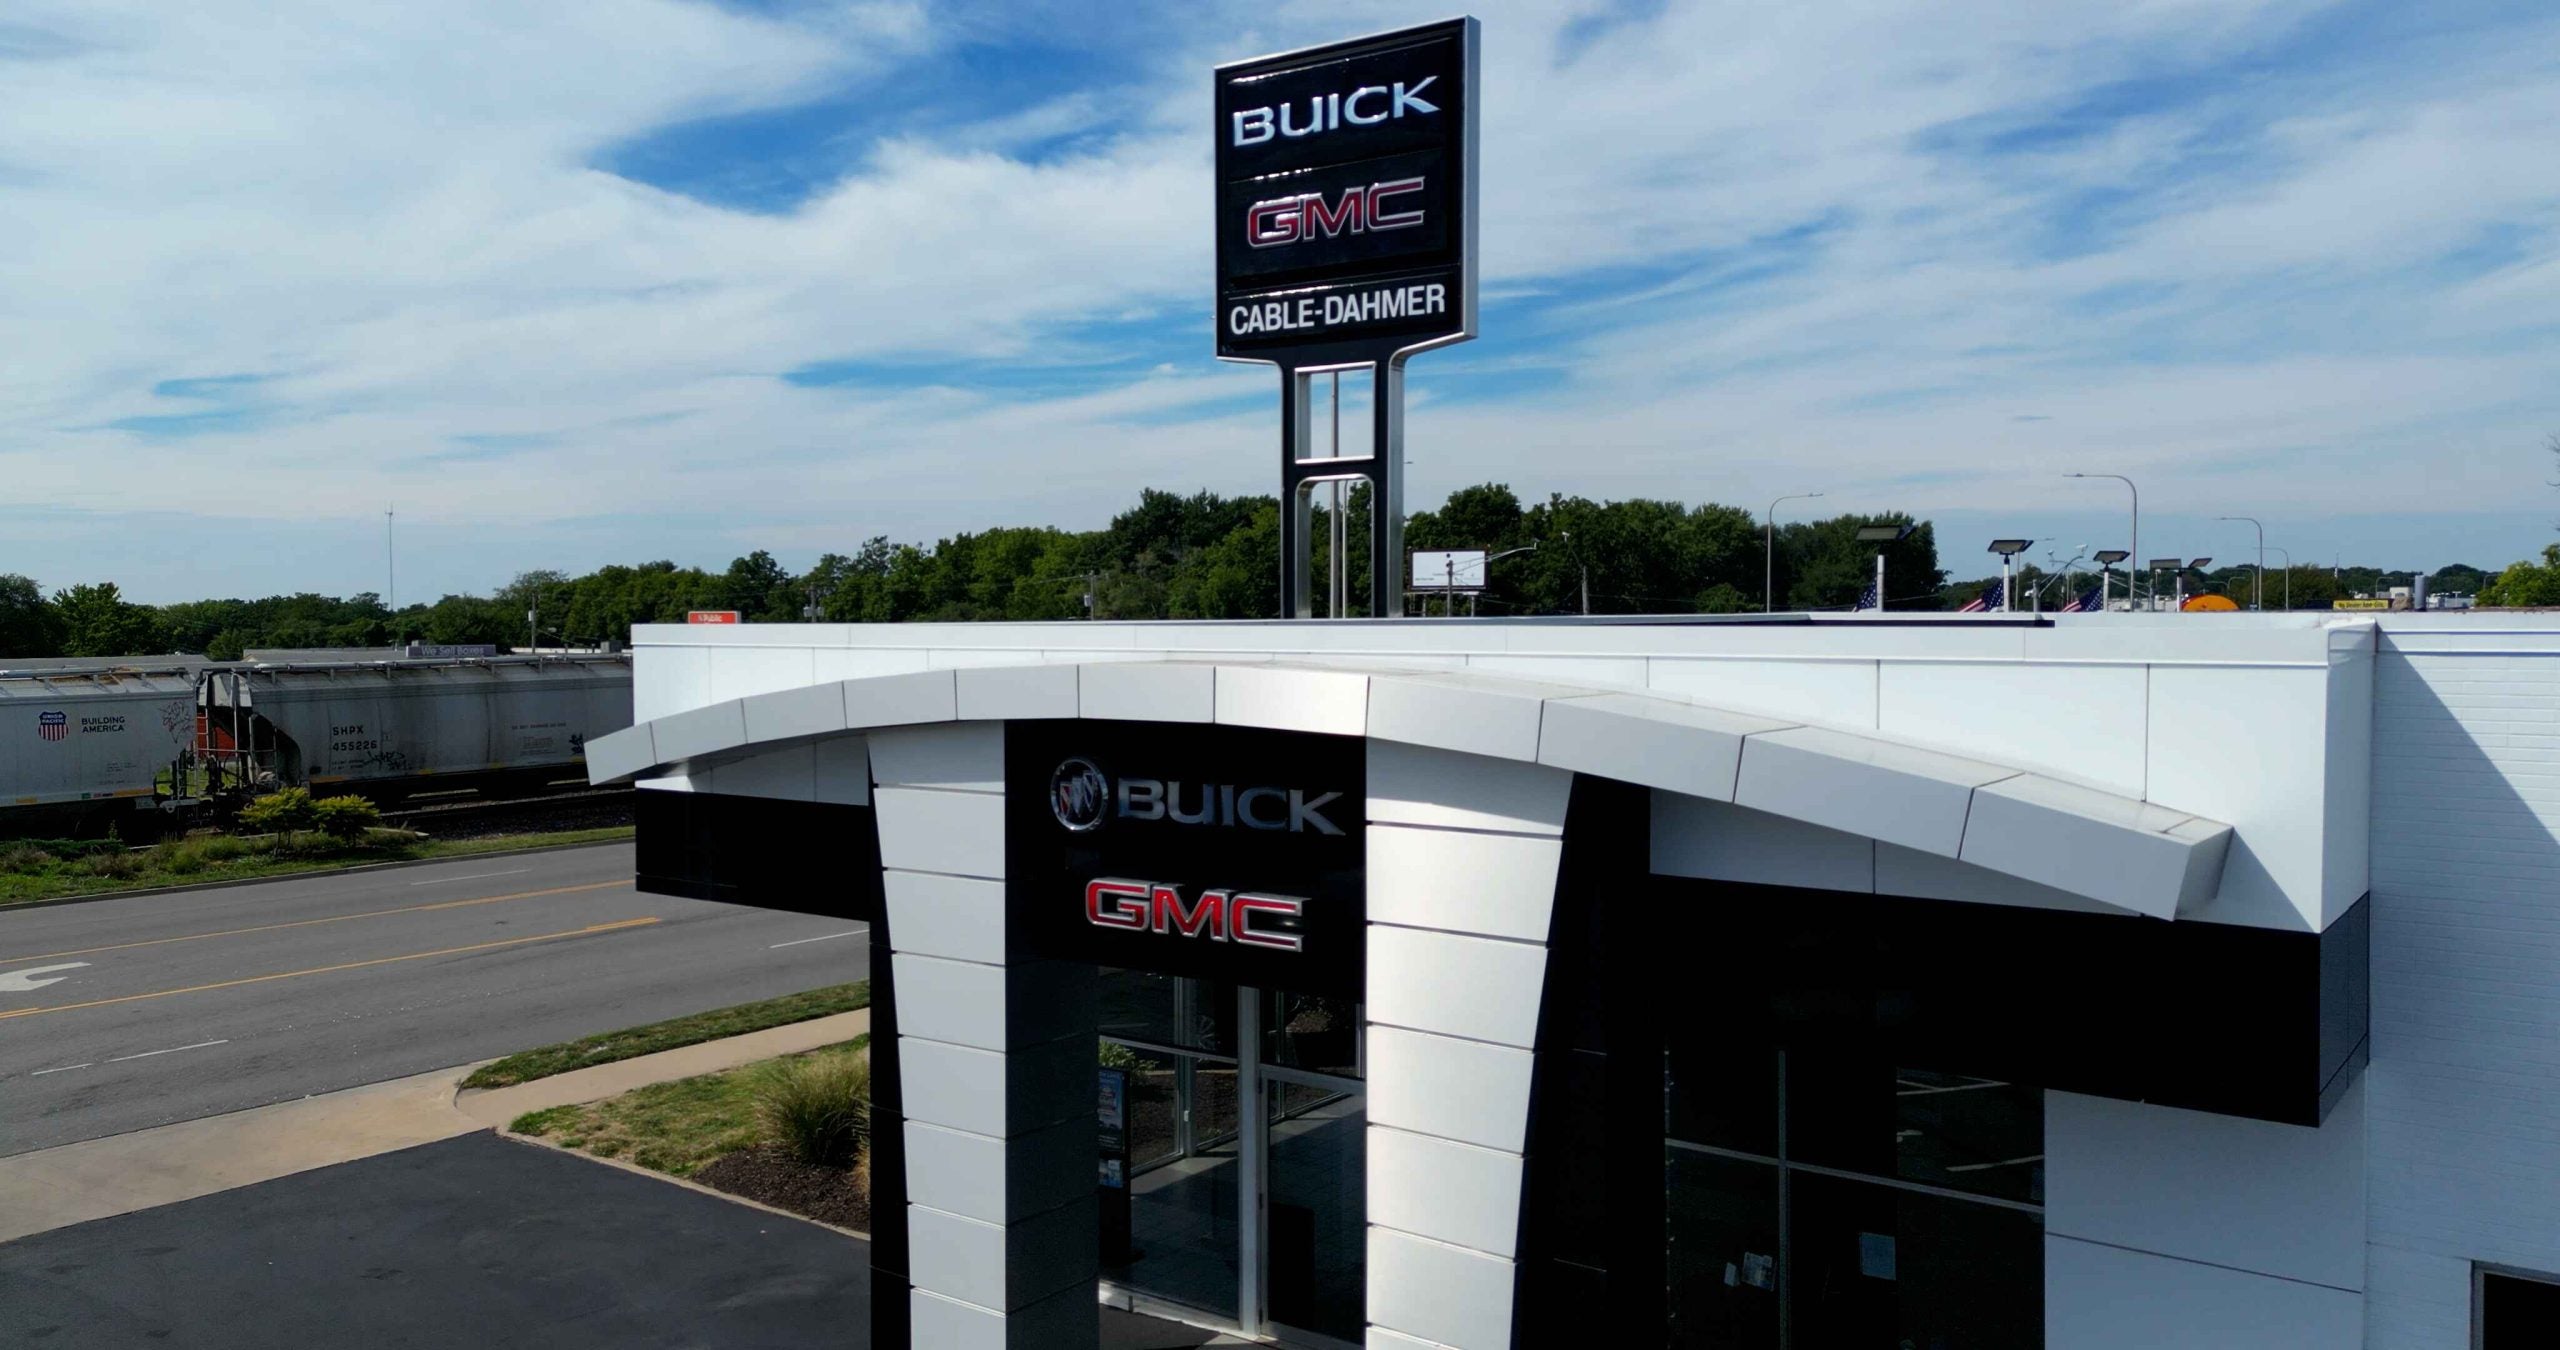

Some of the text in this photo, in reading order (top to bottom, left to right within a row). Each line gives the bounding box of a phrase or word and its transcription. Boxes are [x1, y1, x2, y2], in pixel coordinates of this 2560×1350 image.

[1233, 75, 1441, 147] BUICK
[1248, 176, 1426, 248] GMC
[1230, 283, 1446, 335] CABLE-DAHMER
[421, 646, 485, 656] We Sell Boxes
[81, 716, 125, 726] BUILDING
[82, 724, 125, 734] AMERICA
[332, 725, 364, 736] SHPX
[332, 740, 377, 752] 455226
[1117, 777, 1346, 836] BUICK
[1085, 877, 1311, 952] GMC
